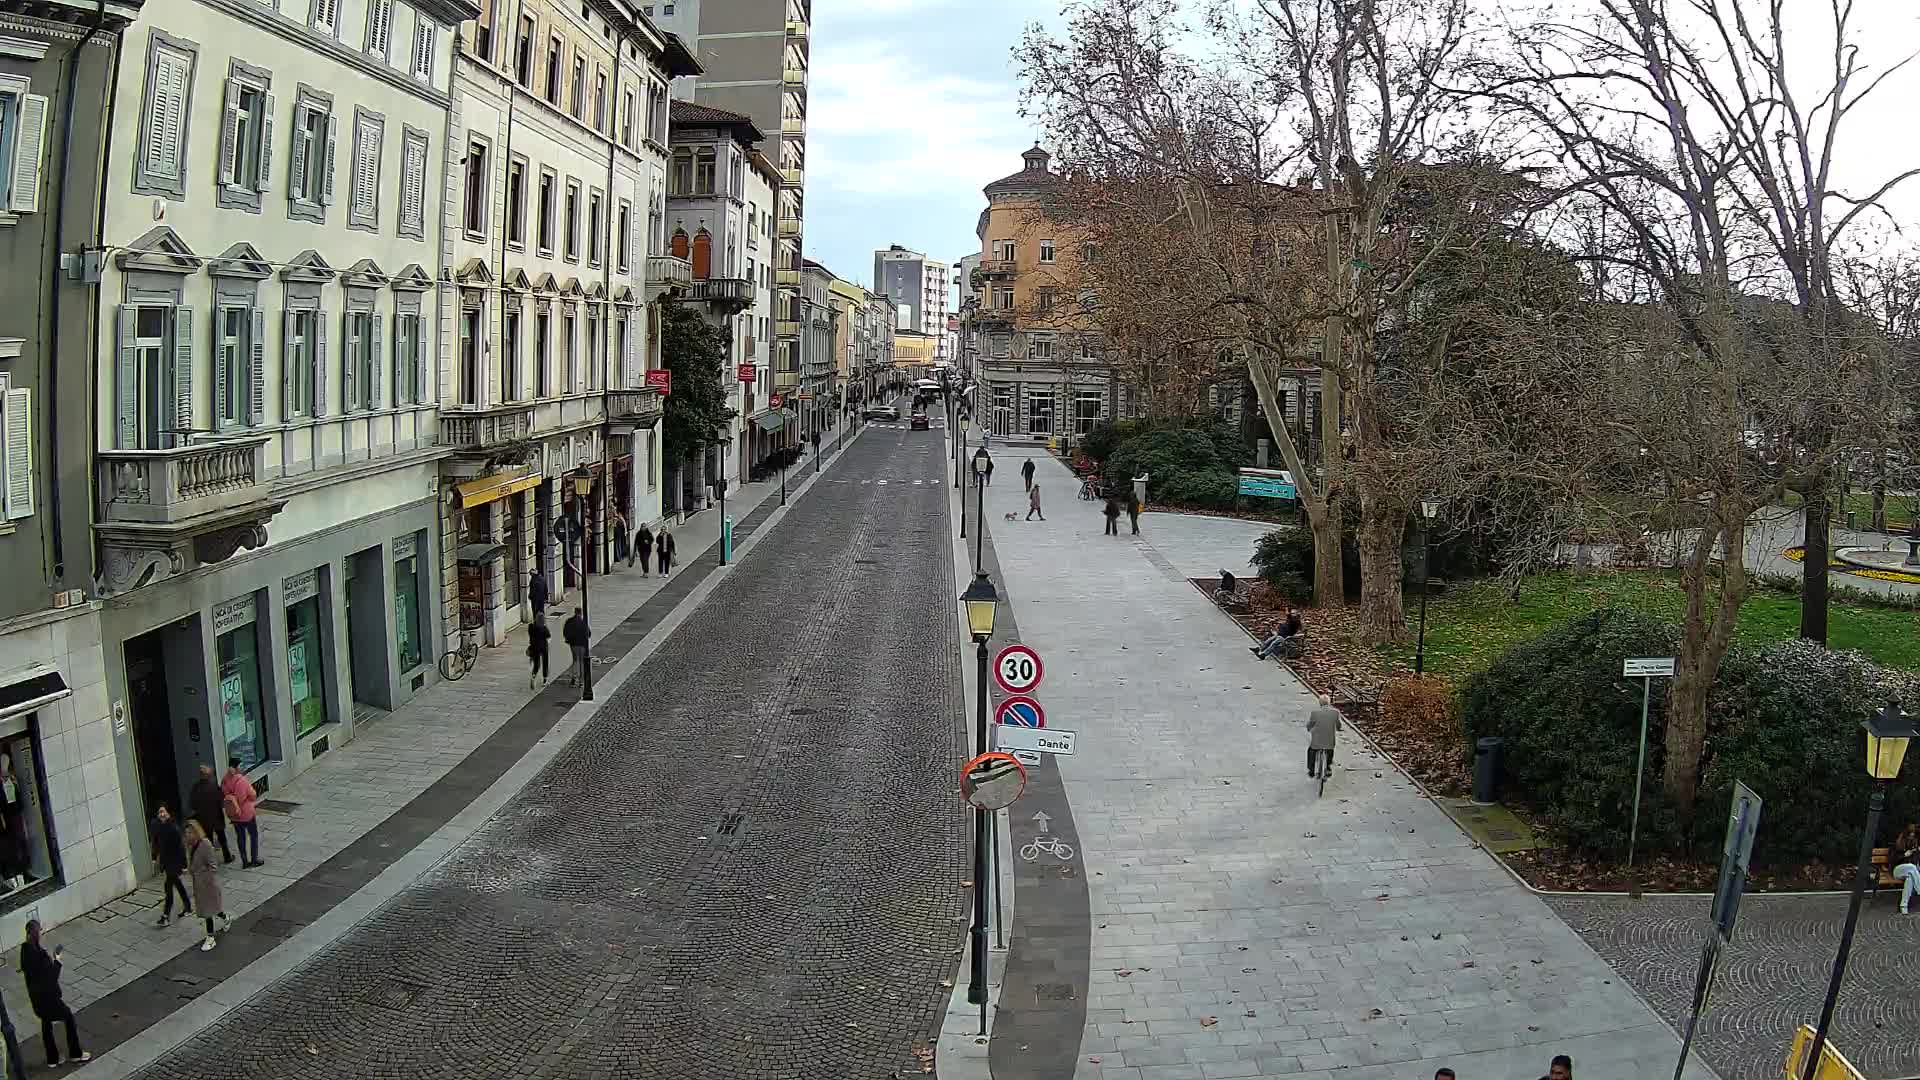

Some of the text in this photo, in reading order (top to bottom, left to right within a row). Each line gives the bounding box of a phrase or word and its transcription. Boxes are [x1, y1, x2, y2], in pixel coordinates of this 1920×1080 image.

[1005, 659, 1033, 681] 30
[222, 677, 241, 701] 130
[1038, 738, 1070, 750] Dante
